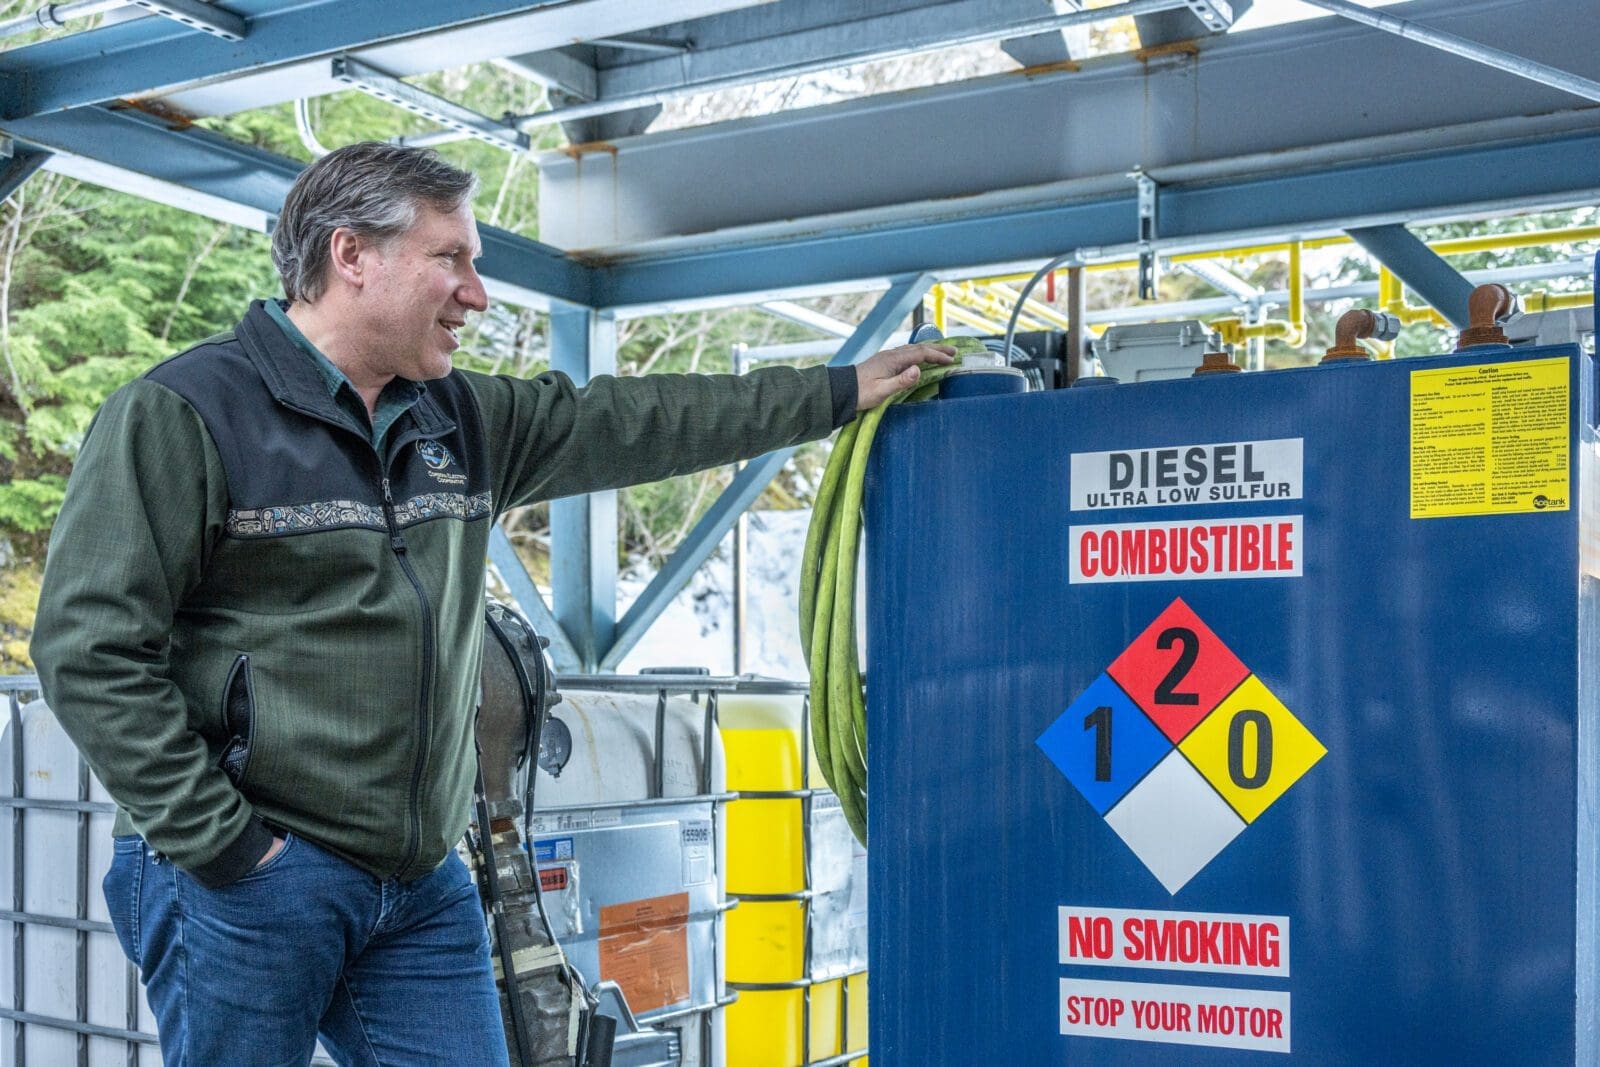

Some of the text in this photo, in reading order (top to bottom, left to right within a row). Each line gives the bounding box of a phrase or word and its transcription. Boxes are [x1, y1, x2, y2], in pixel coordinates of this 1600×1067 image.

[1109, 443, 1265, 490] DIESEL
[1087, 482, 1291, 508] ULTRA LOW SULFUR
[1080, 522, 1293, 578] COMBUSTIBLE
[1154, 626, 1200, 706] 2
[1083, 706, 1113, 782] 1
[1227, 709, 1274, 790] 0
[1068, 916, 1280, 967] NO SMOKING
[1067, 995, 1283, 1039] STOP YOUR MOTOR
